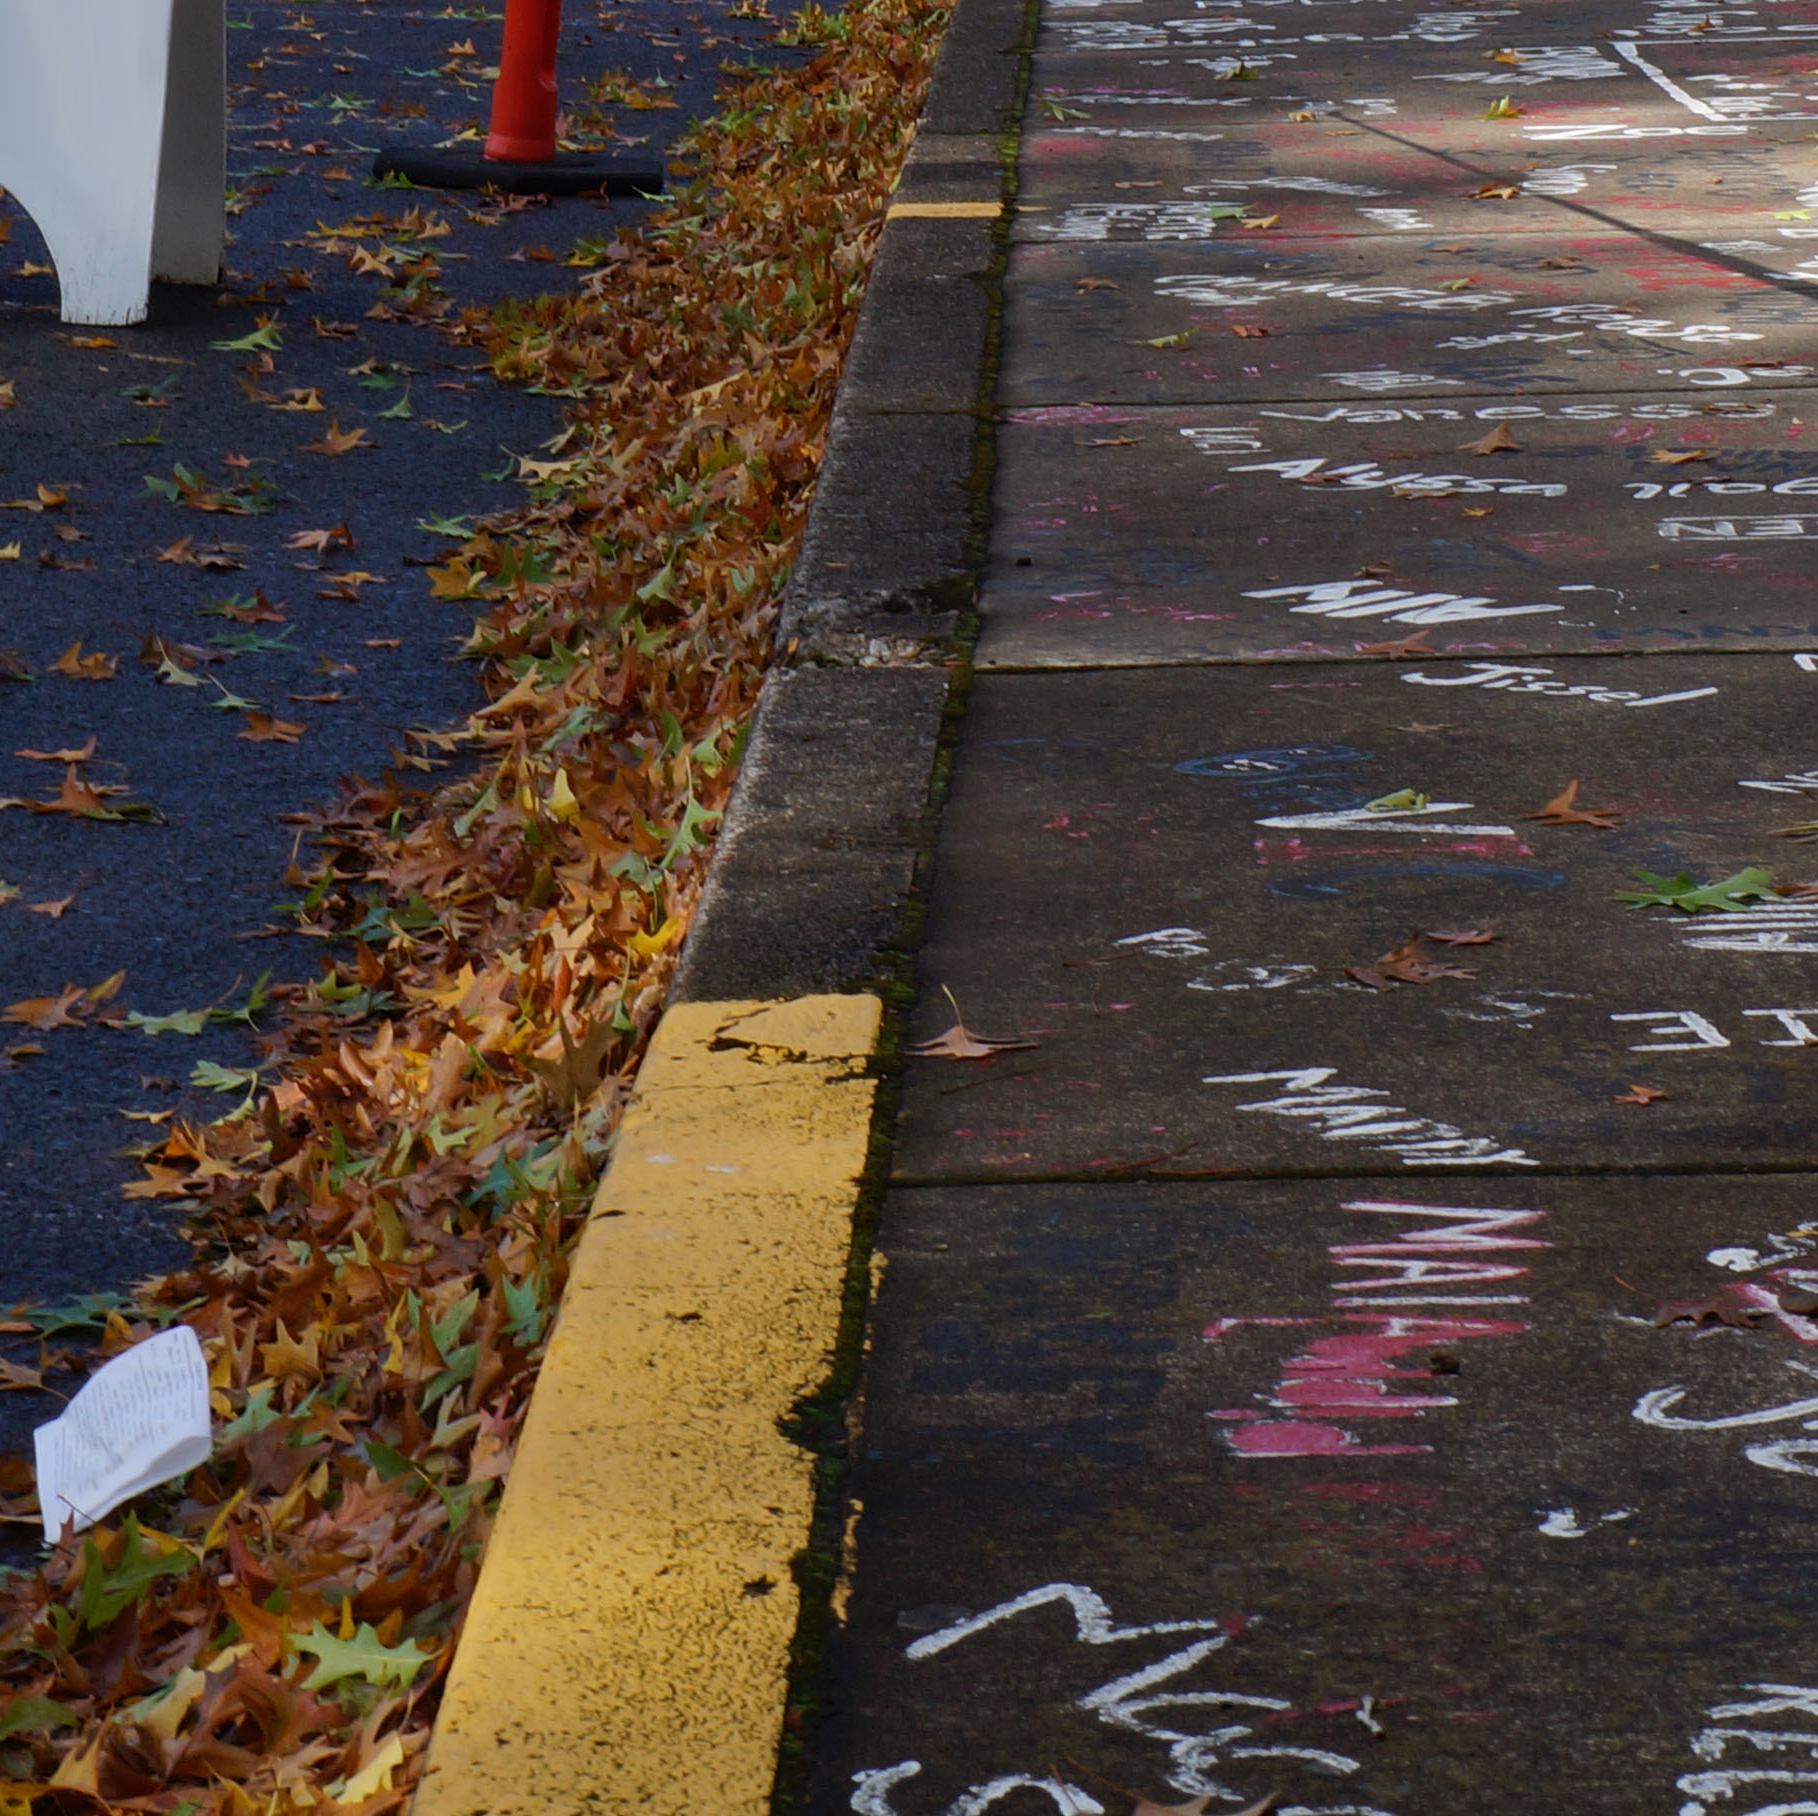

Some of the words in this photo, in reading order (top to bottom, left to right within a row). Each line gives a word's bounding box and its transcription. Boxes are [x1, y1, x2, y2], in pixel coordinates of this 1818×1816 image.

[1523, 124, 1753, 141] Zoe
[1259, 401, 1779, 424] Vanessa
[1225, 456, 1571, 500] Alyssa
[1397, 661, 1719, 708] Jissel
